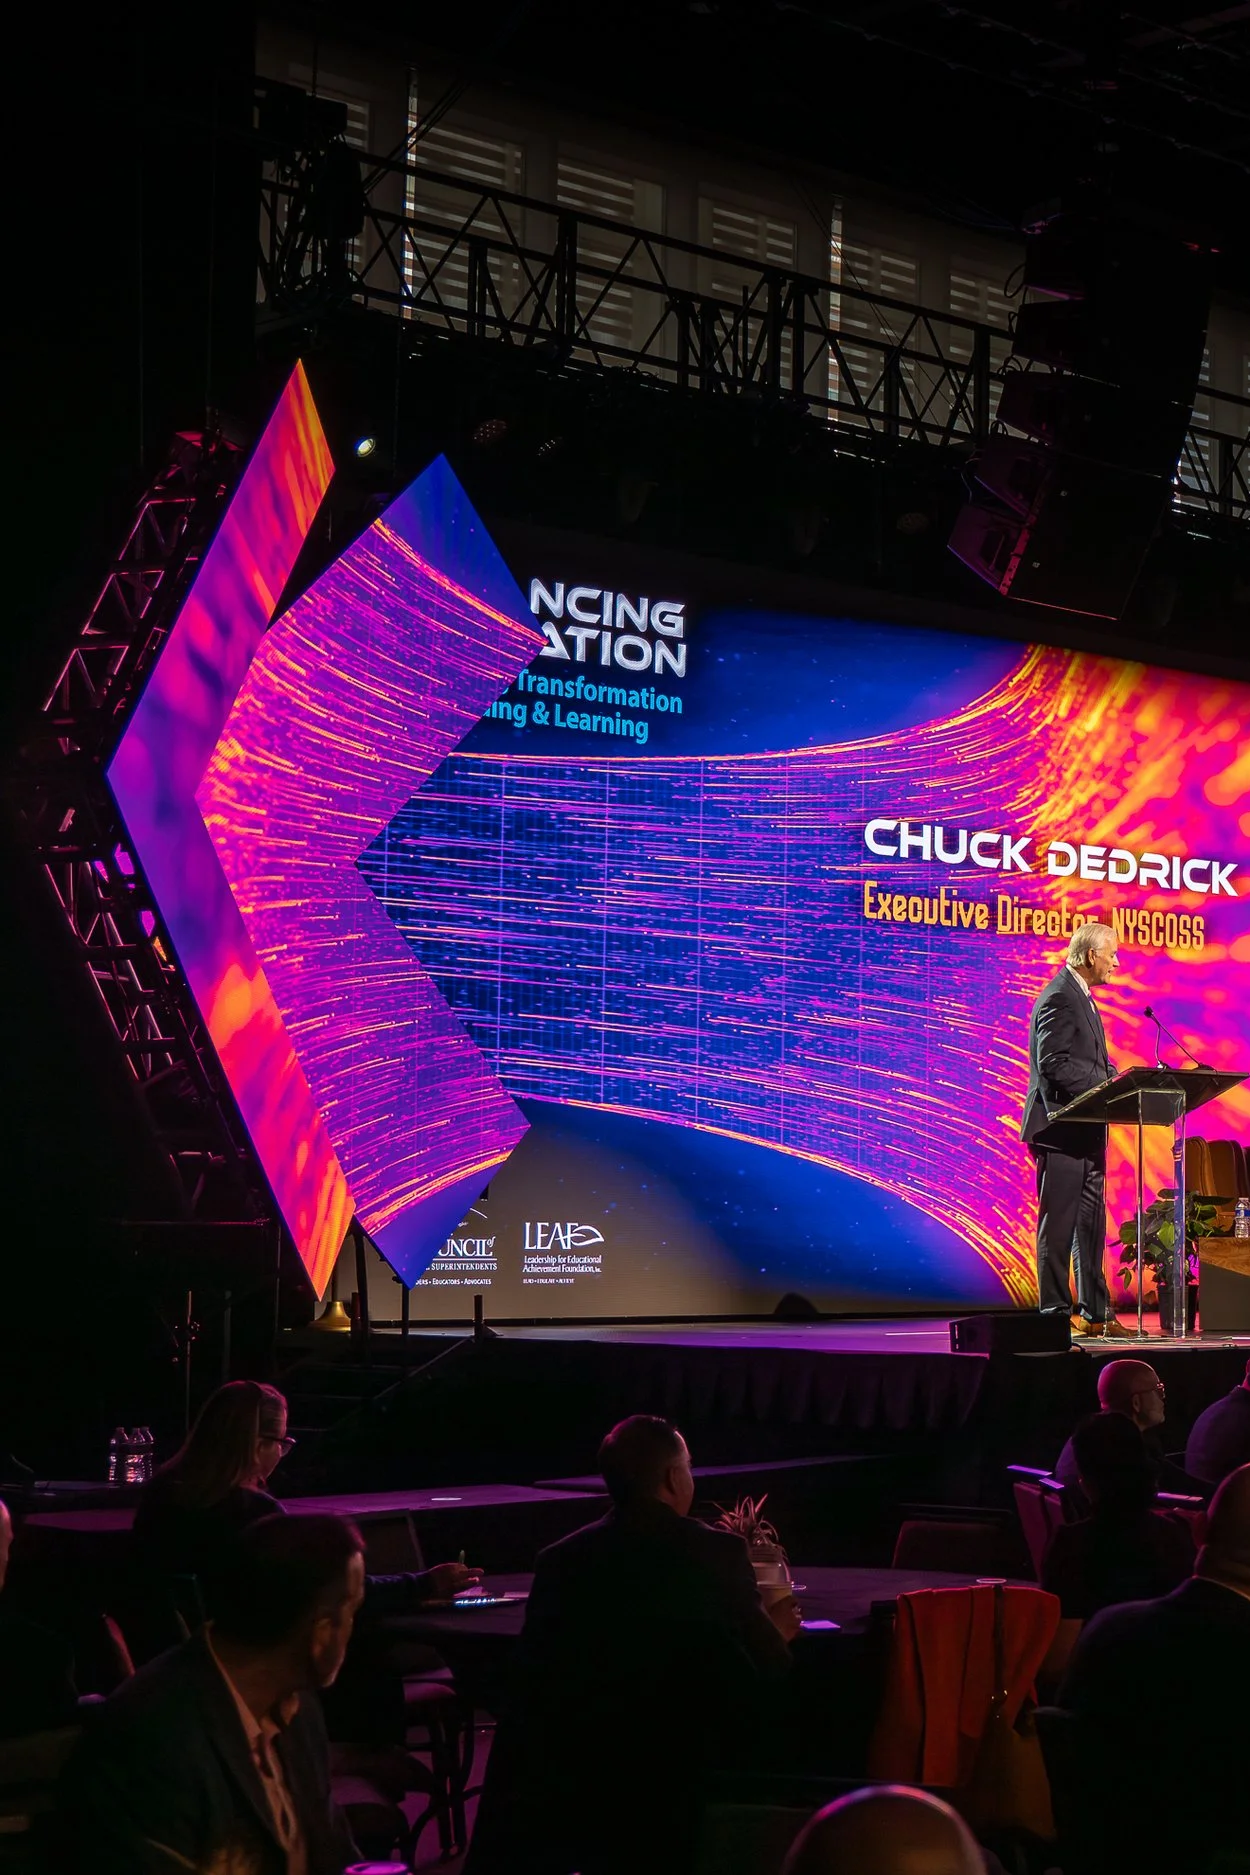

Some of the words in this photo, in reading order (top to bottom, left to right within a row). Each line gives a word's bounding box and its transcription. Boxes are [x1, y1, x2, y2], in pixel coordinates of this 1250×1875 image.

[530, 577, 685, 638] NCING
[539, 621, 687, 678] ATION
[518, 668, 682, 714] Transformation
[532, 701, 549, 726] &
[555, 703, 648, 744] Learning
[864, 818, 1033, 873] CHUCK
[1047, 840, 1238, 897] DEDRICK
[864, 880, 988, 930] Executive
[1112, 906, 1205, 950] NYSCOSS
[524, 1222, 588, 1249] LEAF
[431, 1262, 498, 1271] SUPERINTENDENTS
[522, 1264, 561, 1273] Achievement
[524, 1255, 556, 1266] Leadership
[558, 1255, 566, 1264] for
[567, 1255, 602, 1264] Educational
